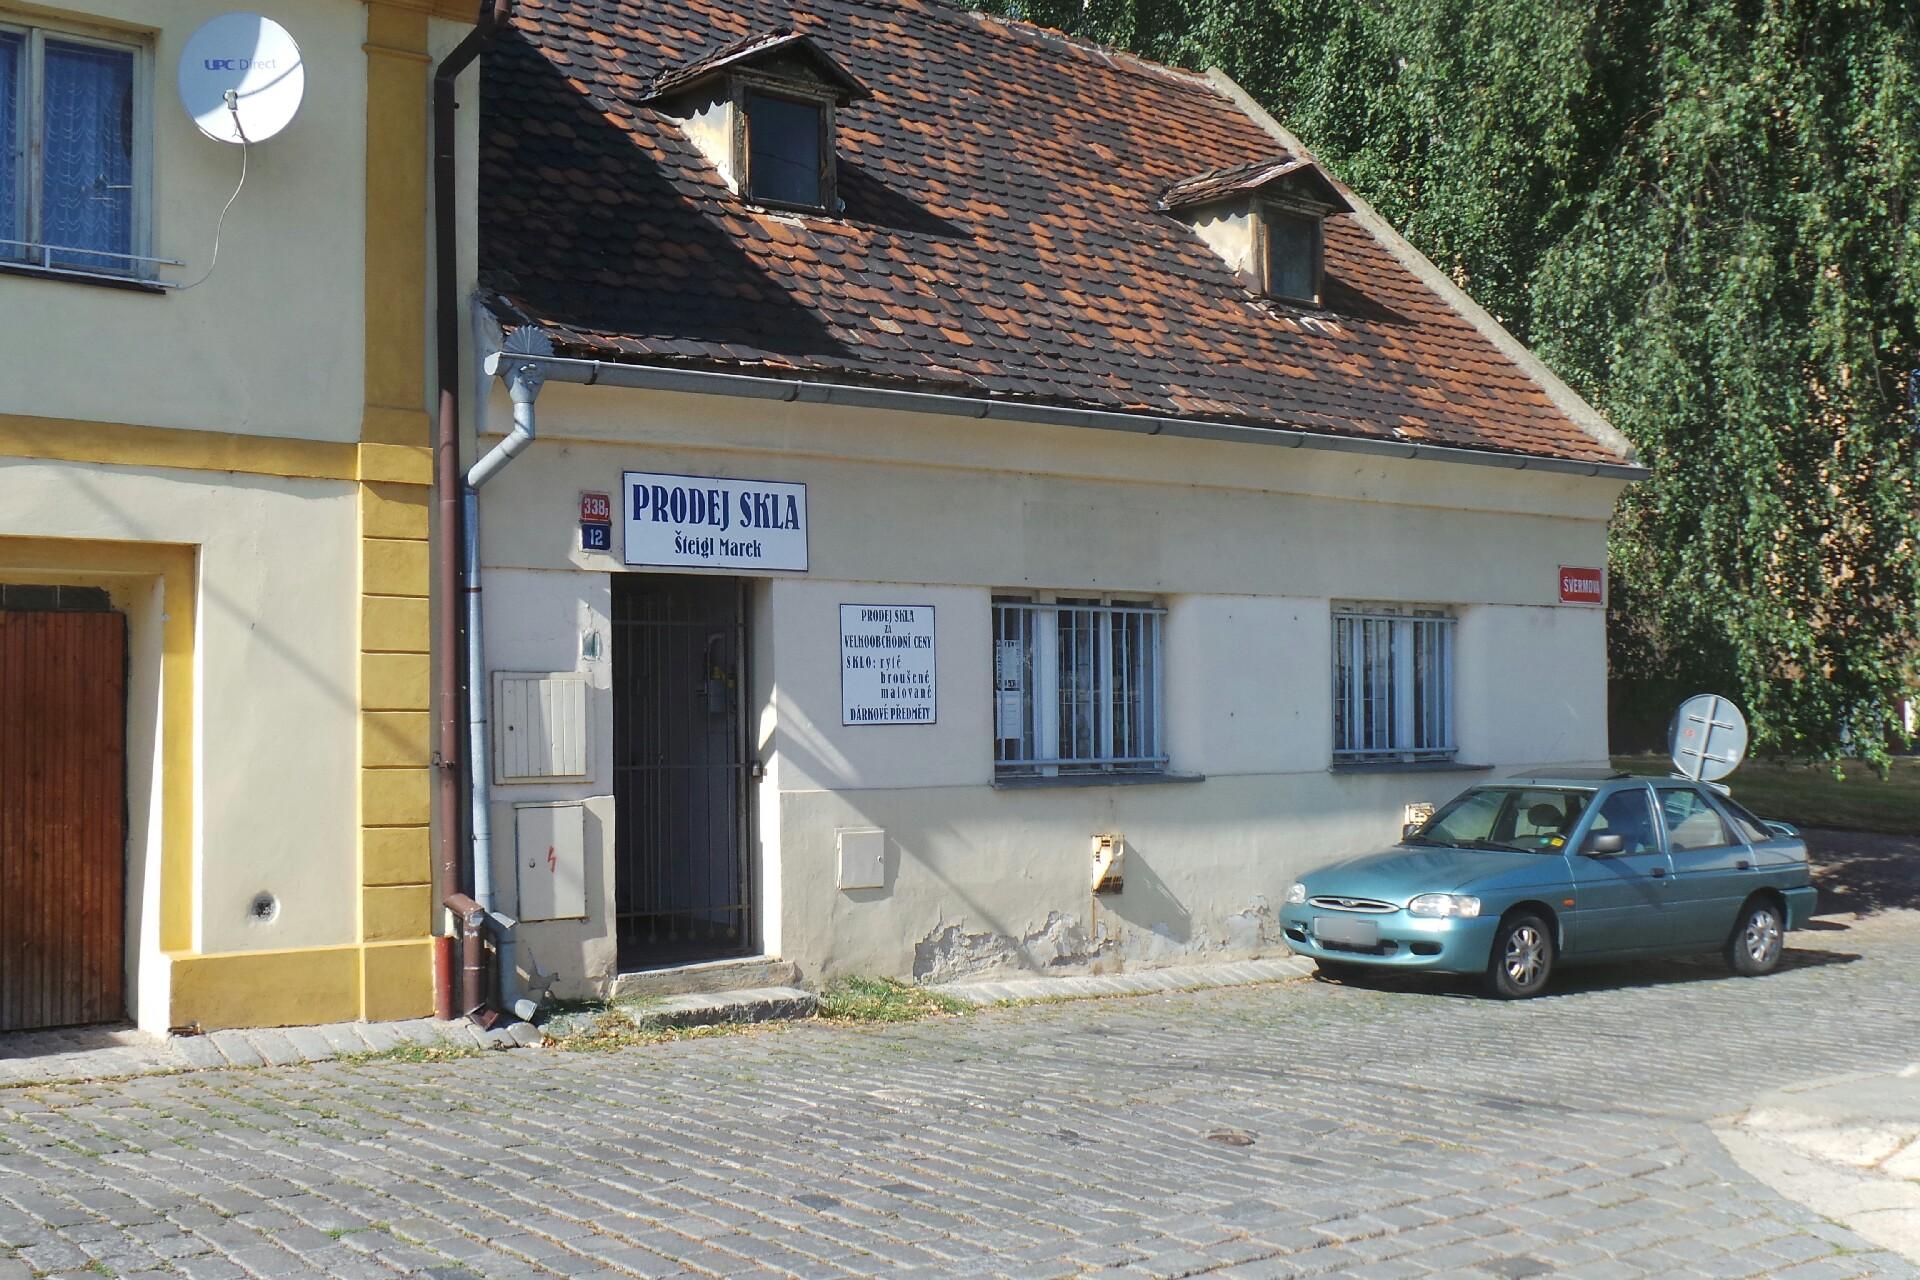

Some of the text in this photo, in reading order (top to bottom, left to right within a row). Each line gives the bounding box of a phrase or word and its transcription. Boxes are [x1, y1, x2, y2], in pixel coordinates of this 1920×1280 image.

[204, 58, 276, 71] UPC Direct
[632, 484, 800, 531] PRODEJ SKLA
[590, 528, 603, 545] 12
[675, 530, 762, 559] Šteigl Marek
[1563, 576, 1600, 593] ŠVERMOVA
[861, 609, 915, 624] PRODEJ SKLA
[844, 633, 932, 648] VELKOOBCHODNÍ CENY
[846, 655, 902, 671] SKLO: ryté
[880, 669, 930, 684] broušené
[881, 684, 932, 699] malované
[850, 703, 930, 721] DÁRKOVÉ PŘEDMĚTY
